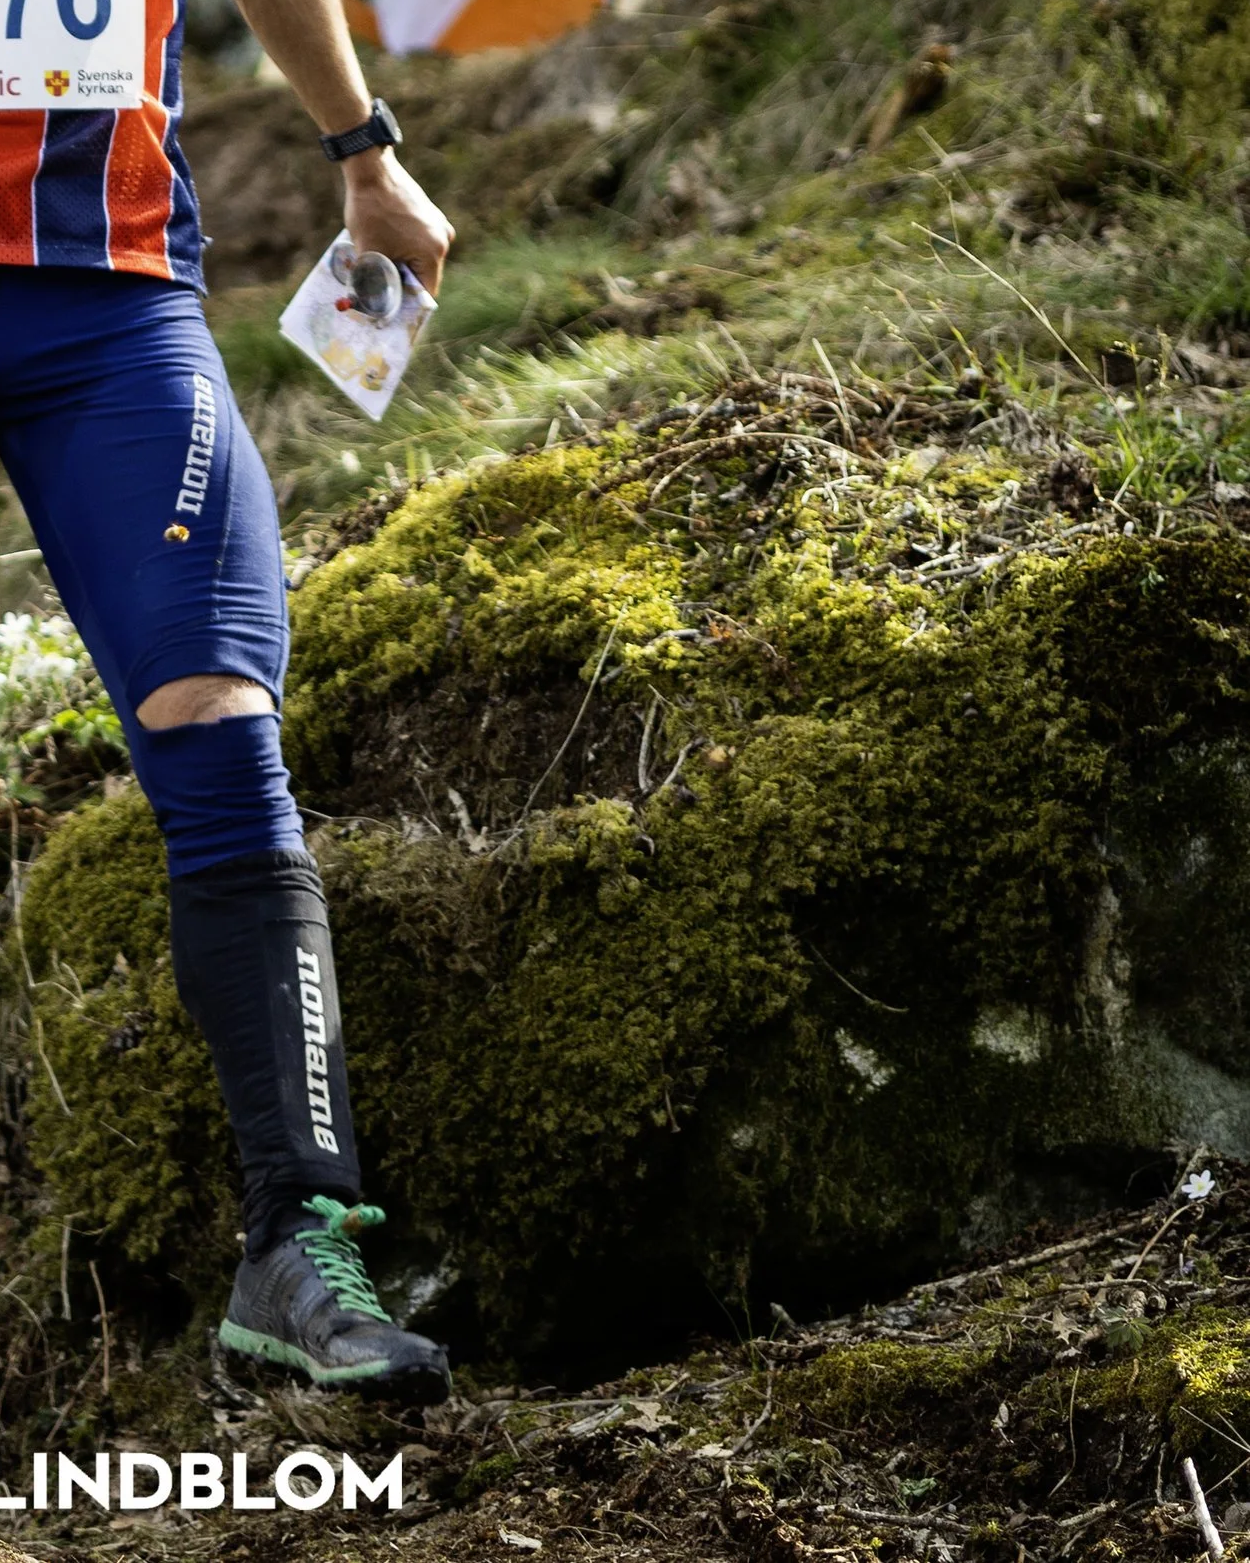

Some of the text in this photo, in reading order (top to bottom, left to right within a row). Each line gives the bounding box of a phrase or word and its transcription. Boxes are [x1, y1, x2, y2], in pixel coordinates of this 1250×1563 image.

[78, 70, 133, 82] Svenska
[78, 83, 124, 97] kyrkan
[175, 372, 216, 515] noname
[295, 946, 339, 1155] noname
